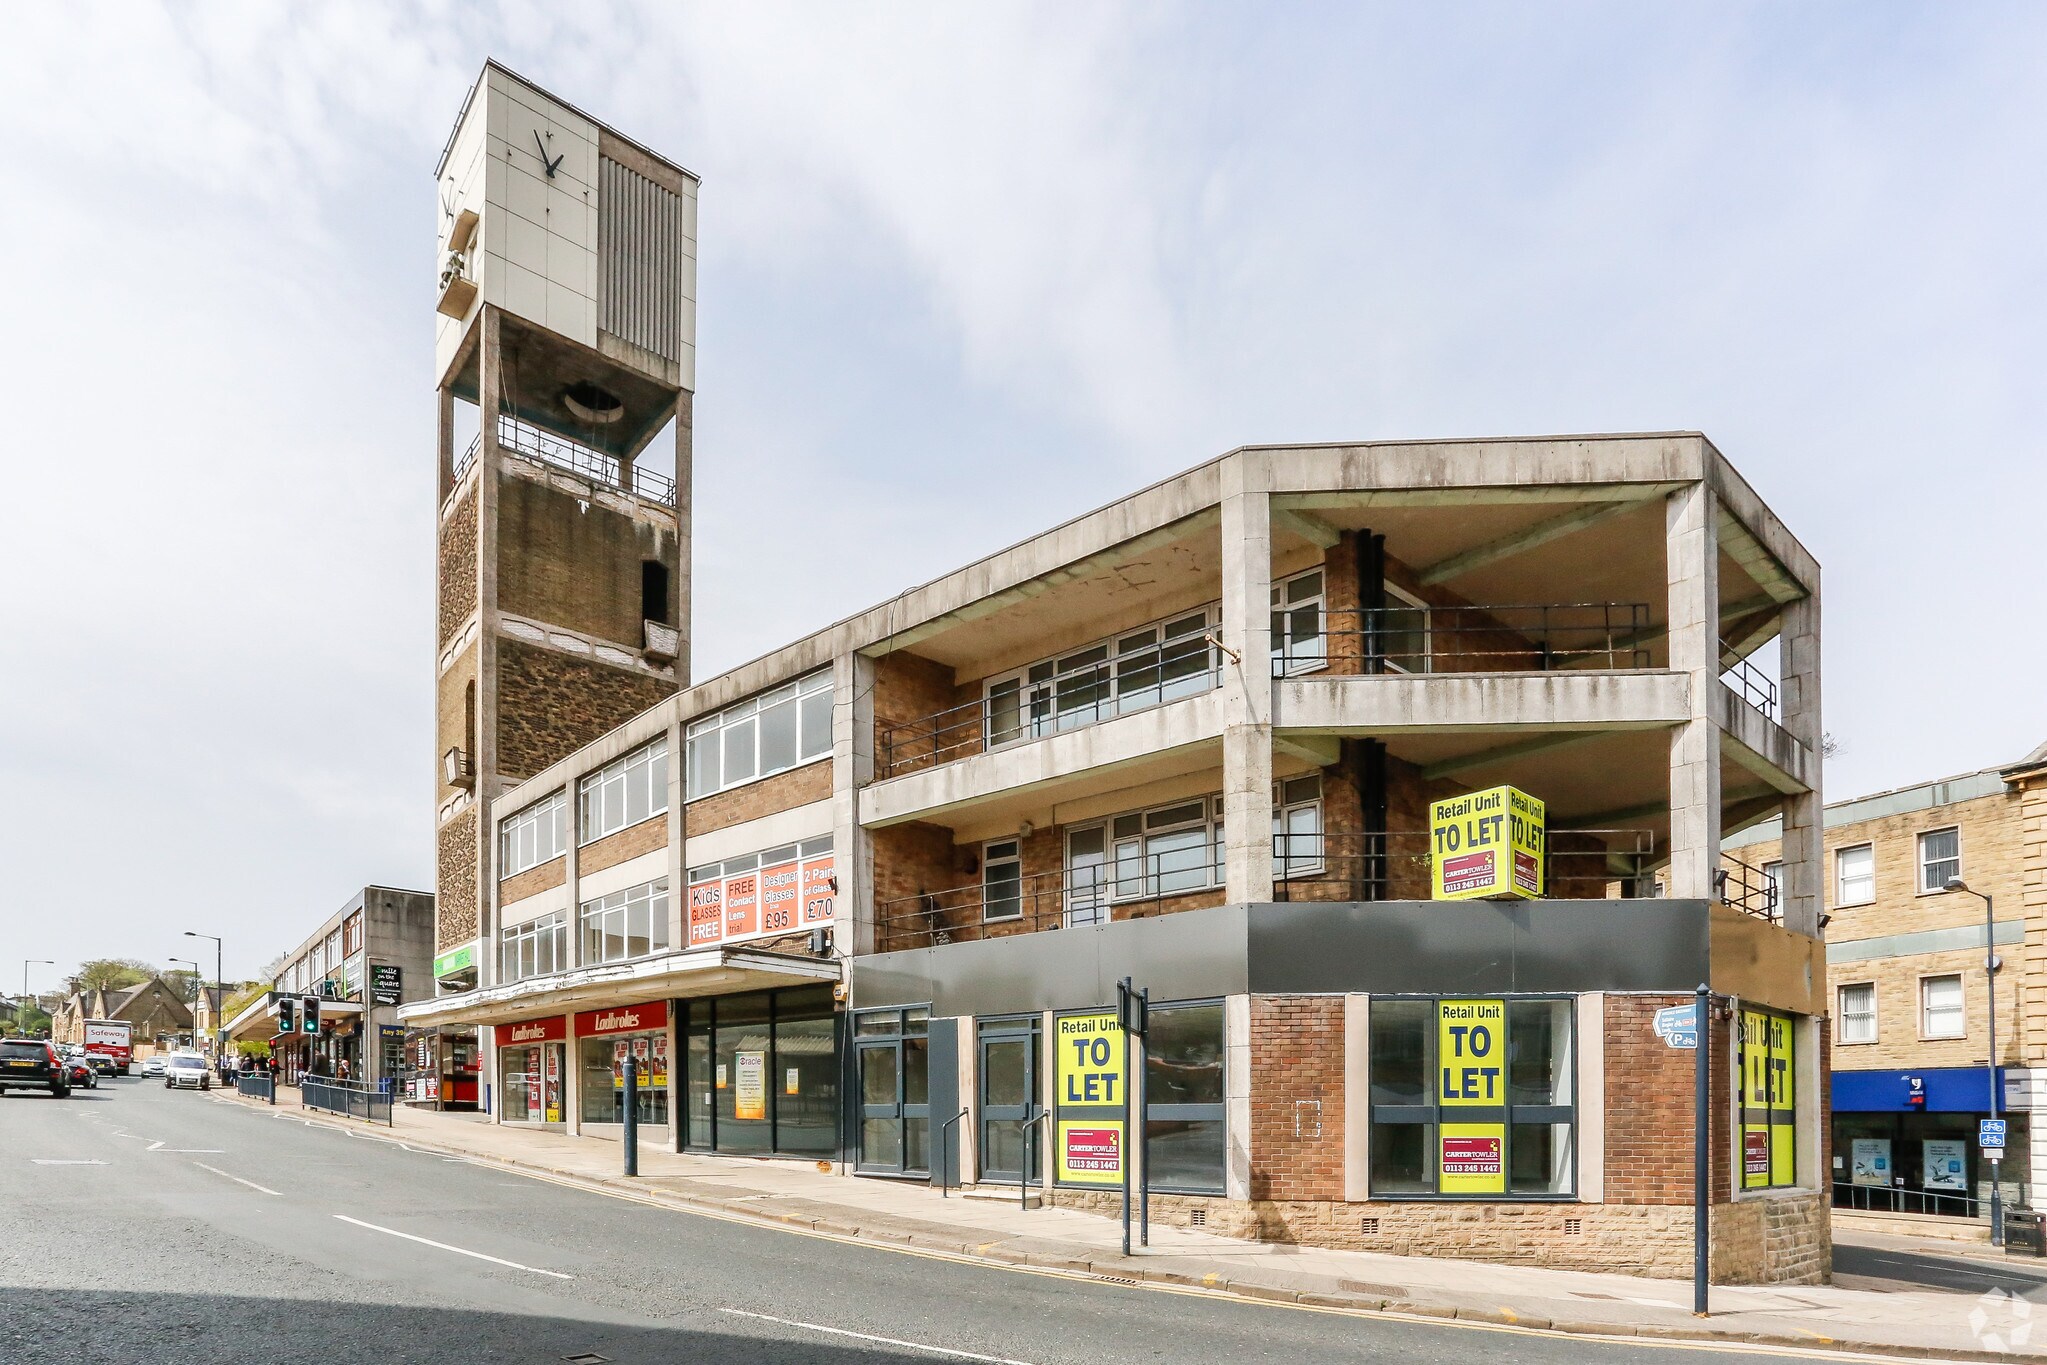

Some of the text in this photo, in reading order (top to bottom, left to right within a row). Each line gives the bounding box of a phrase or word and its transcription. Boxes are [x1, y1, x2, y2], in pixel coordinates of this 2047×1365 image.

[1437, 793, 1501, 821] Retail Unit
[1511, 792, 1542, 820] Retail Unit
[1435, 815, 1503, 854] TO LET
[1510, 814, 1543, 853] TO LET
[804, 870, 811, 883] 2
[1445, 863, 1493, 878] CARTERTOWLER
[765, 872, 798, 887] Designer
[1446, 877, 1493, 892] 0113 245 1447
[729, 879, 754, 896] FREE
[804, 886, 811, 895] of
[694, 886, 720, 906] Kids
[729, 895, 755, 907] Contact
[765, 889, 794, 902] Glasses
[692, 905, 721, 921] GLASSES
[729, 910, 746, 920] Lens
[808, 898, 833, 919] £70
[766, 910, 788, 929] £95
[693, 921, 719, 940] FREE
[729, 923, 742, 933] trial
[376, 966, 397, 974] Smile
[373, 978, 399, 988] Square
[1443, 1006, 1500, 1018] Retail Unit
[595, 1011, 639, 1031] Ladbrokes
[1062, 1019, 1095, 1033] Retail
[91, 1030, 125, 1038] Safeway
[512, 1024, 545, 1041] Ladbrokes
[1674, 1033, 1683, 1045] P
[1449, 1025, 1491, 1058] TO
[1073, 1037, 1110, 1066] TO
[1068, 1073, 1118, 1101] LET
[1444, 1068, 1500, 1099] LET
[1069, 1160, 1117, 1170] 0113 245 1447
[1445, 1164, 1498, 1172] 0113 245 1447
